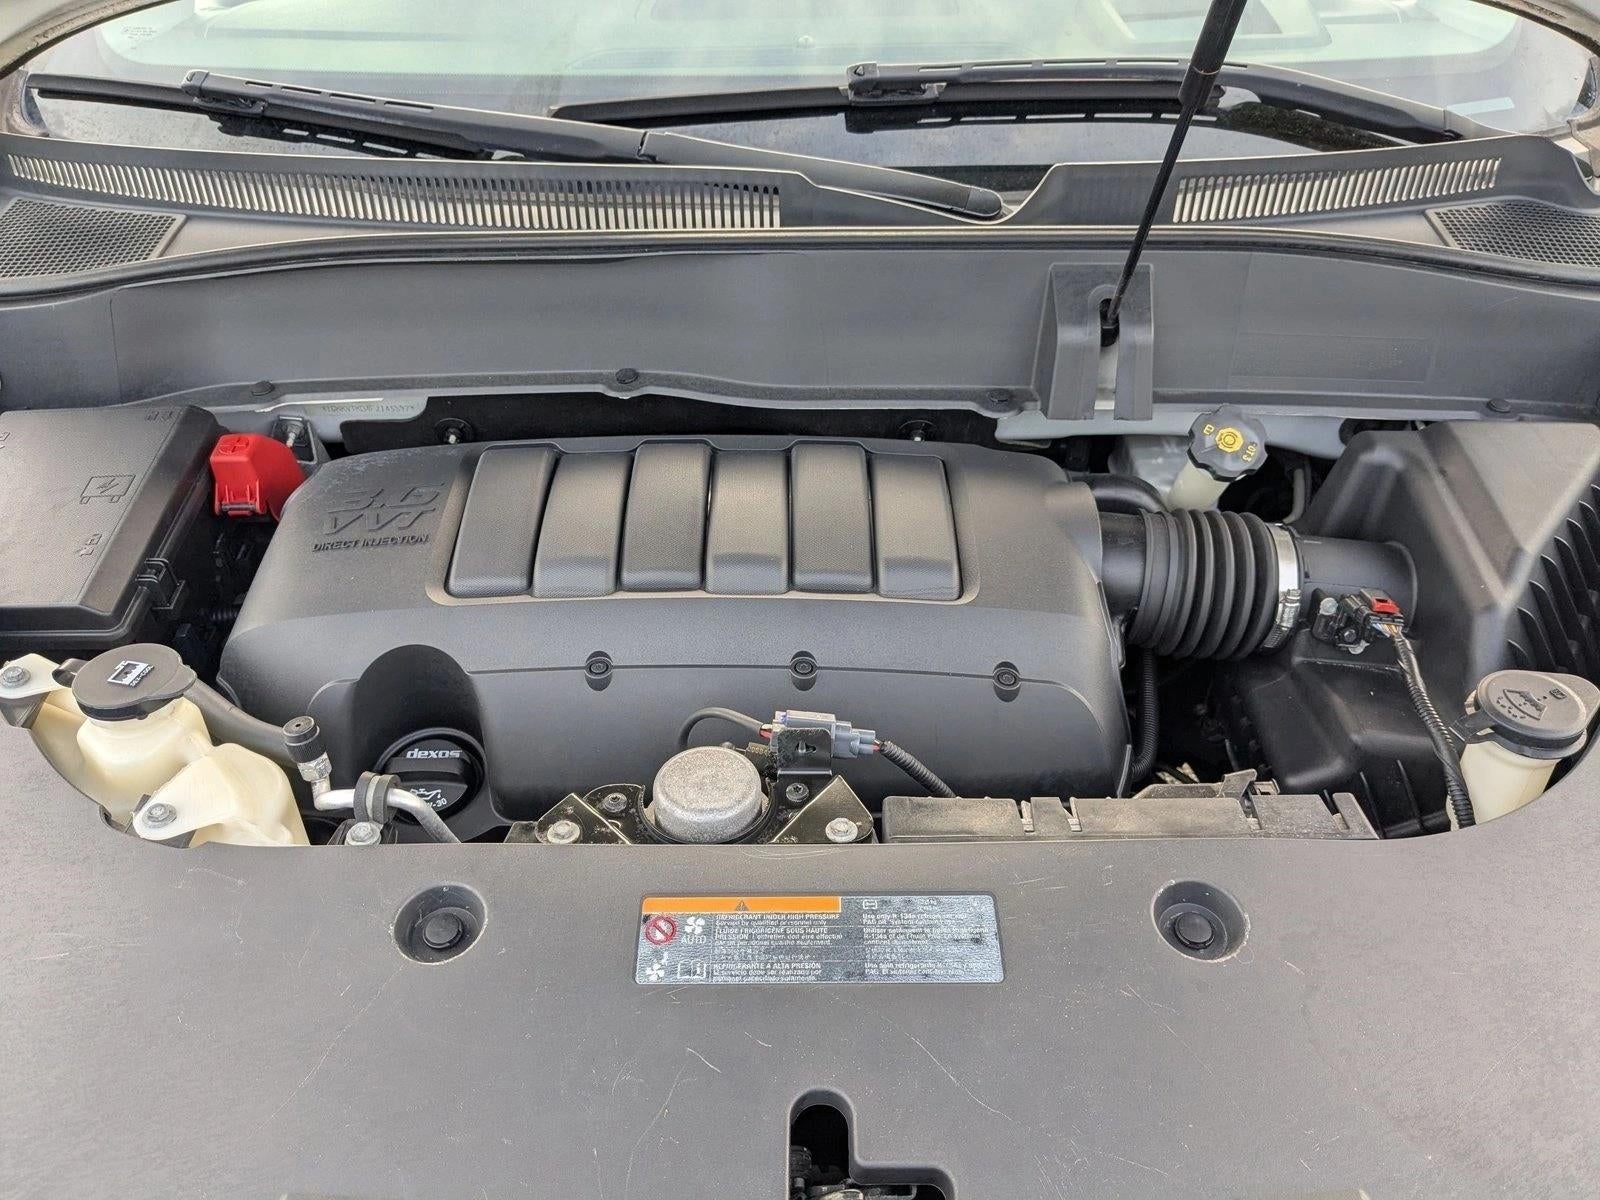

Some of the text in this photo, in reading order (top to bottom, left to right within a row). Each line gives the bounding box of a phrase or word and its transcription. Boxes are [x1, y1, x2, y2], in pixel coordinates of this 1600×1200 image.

[325, 482, 445, 514] 3.6
[323, 507, 436, 535] VVT
[312, 534, 430, 552] DIRECT INJECTION
[406, 748, 463, 759] dexos
[681, 936, 706, 944] AUTO
